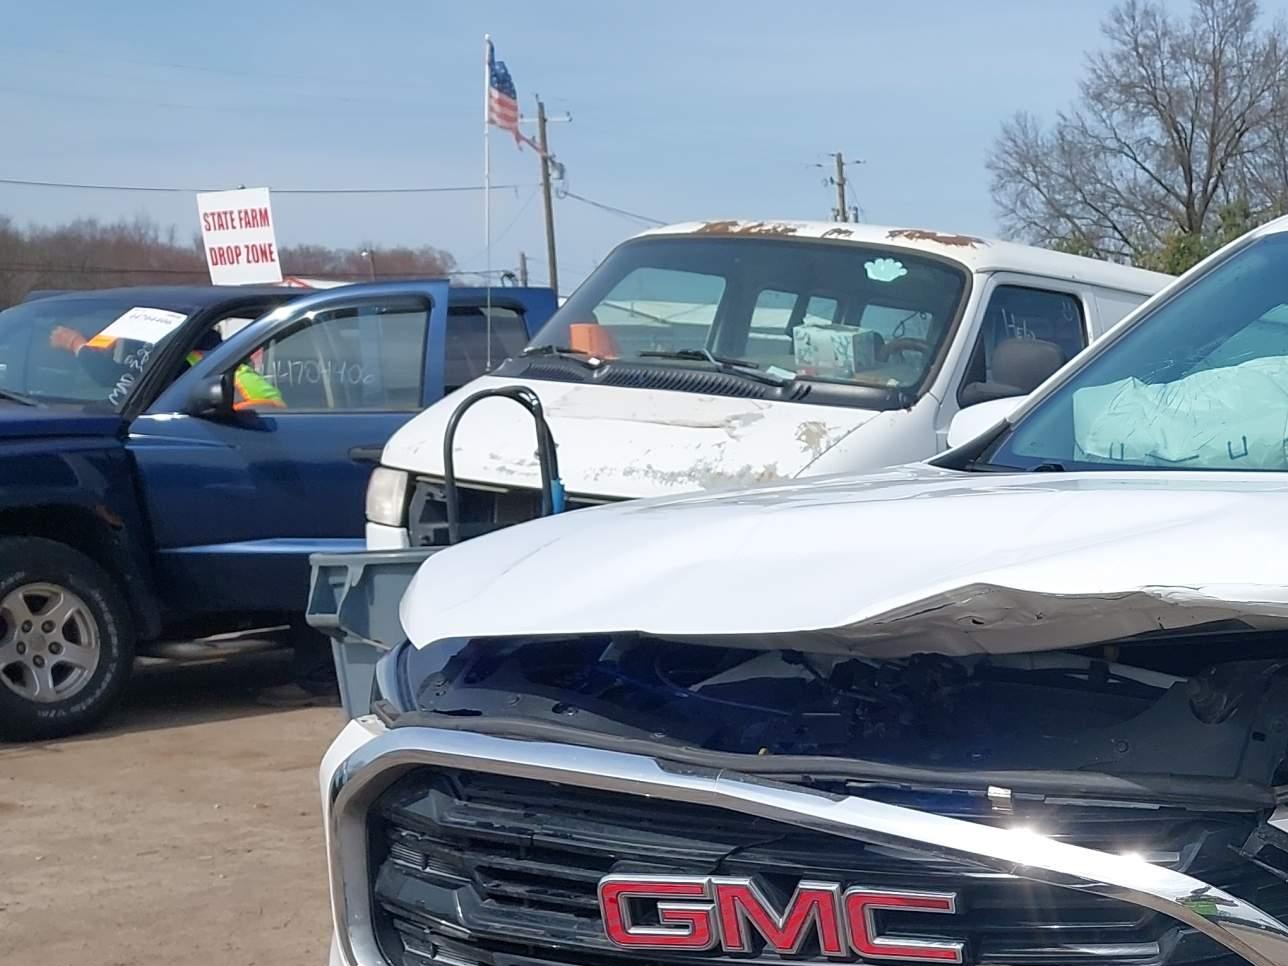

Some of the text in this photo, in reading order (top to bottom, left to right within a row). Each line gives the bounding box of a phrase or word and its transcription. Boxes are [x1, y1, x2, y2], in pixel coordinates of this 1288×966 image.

[203, 207, 270, 231] STATE FARM
[209, 243, 276, 266] DROP ZONE
[597, 873, 964, 964] GMC
